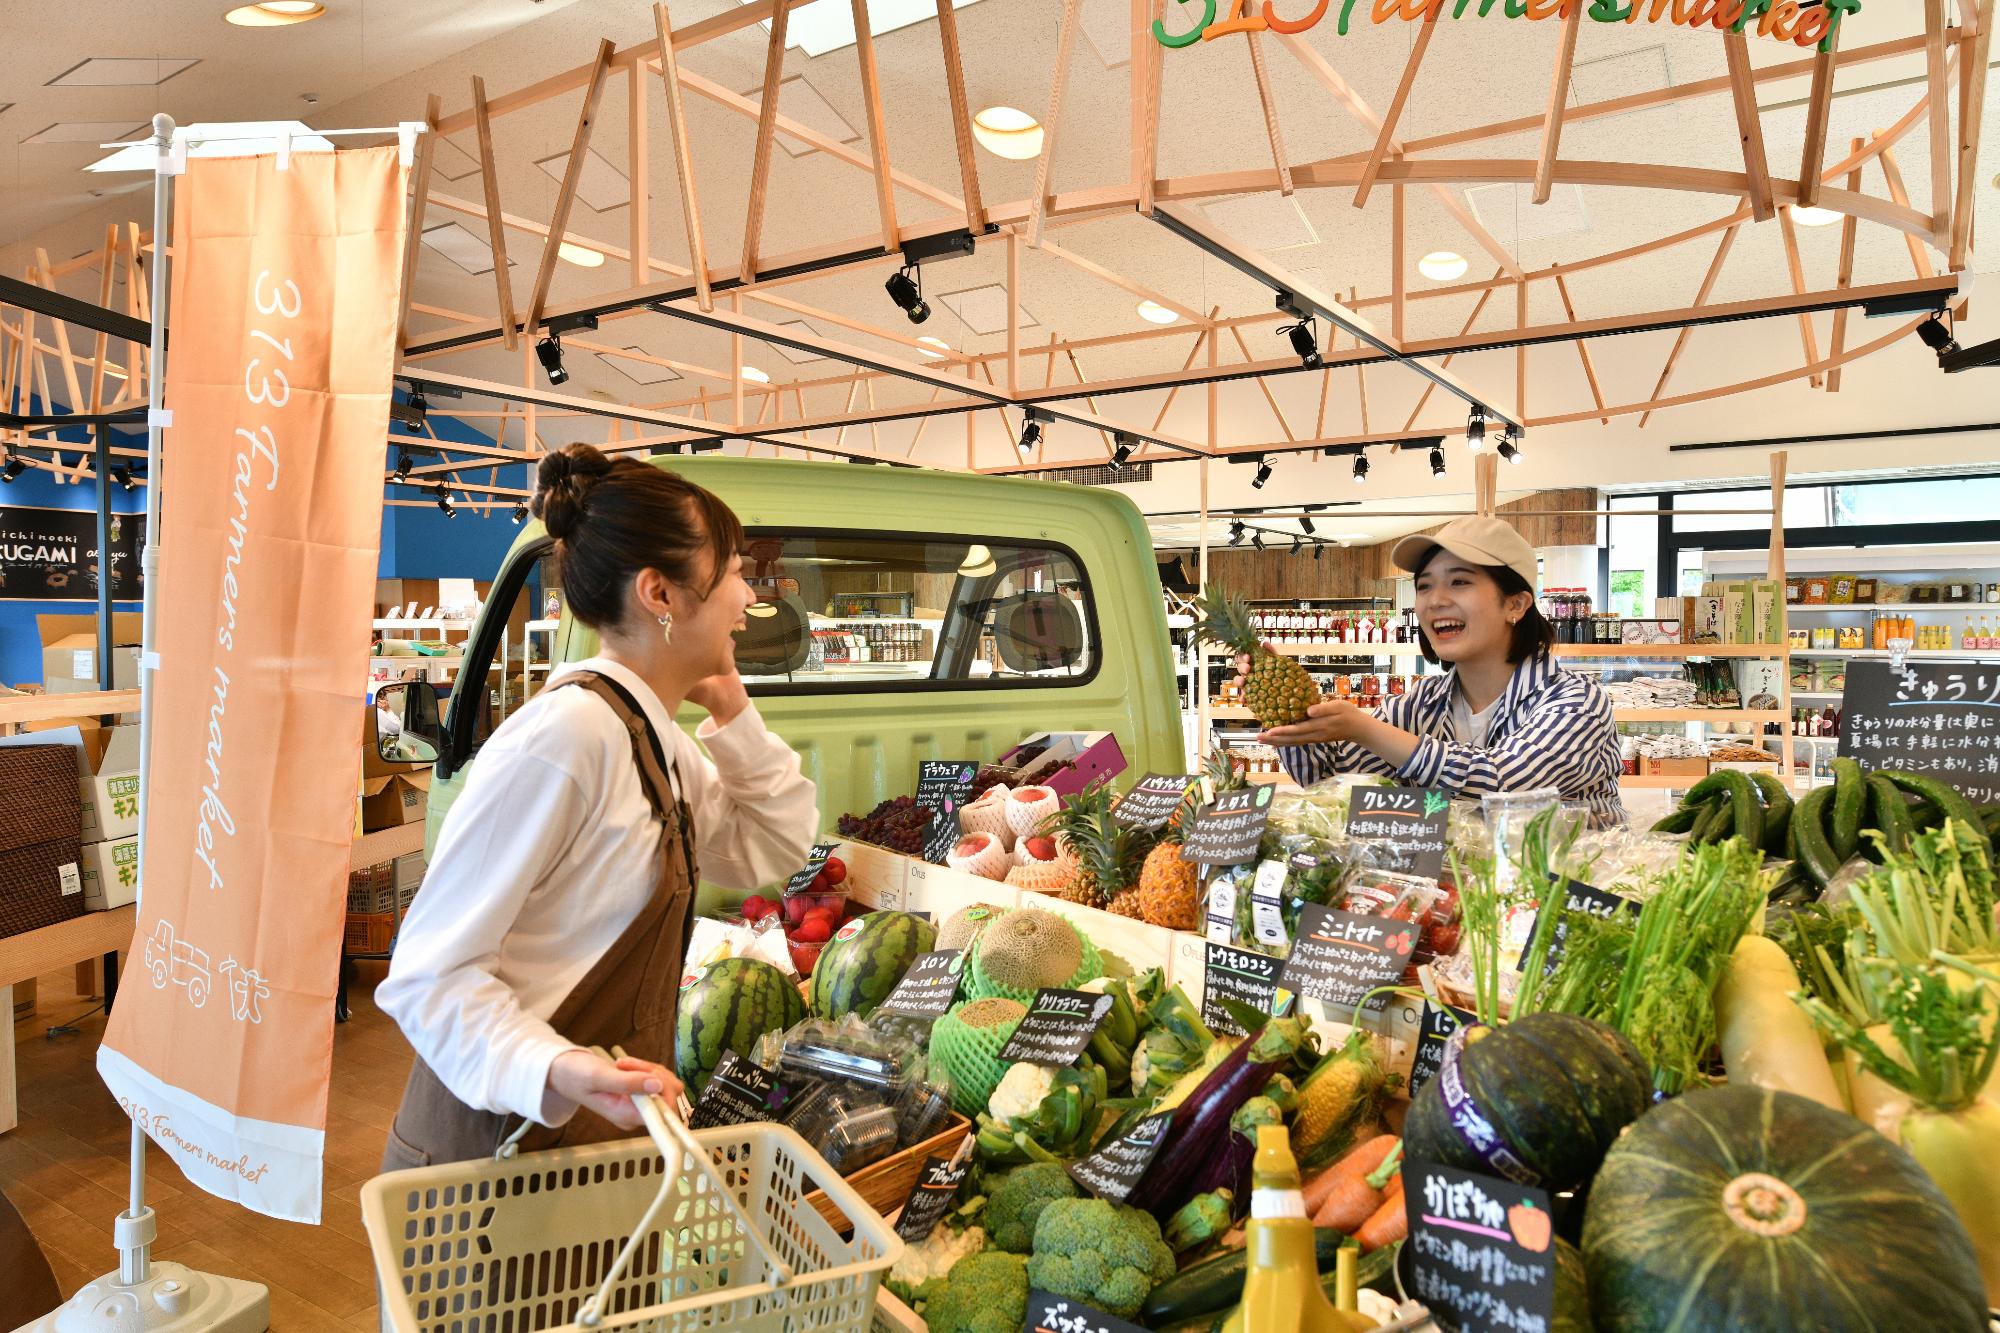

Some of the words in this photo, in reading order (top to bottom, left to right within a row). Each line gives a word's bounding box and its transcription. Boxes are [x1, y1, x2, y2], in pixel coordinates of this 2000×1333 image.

[245, 269, 301, 408] 313
[1896, 669, 2000, 704] きゅうり
[195, 665, 236, 889] market
[924, 761, 960, 778] デラウェア
[1215, 793, 1250, 812] レタス
[1363, 791, 1417, 810] クレソン
[1316, 913, 1384, 943] ミニトマト
[915, 955, 949, 973] メロン
[1208, 945, 1274, 976] トウモロコシ
[1038, 992, 1090, 1012] カリフラワー
[206, 1154, 268, 1185] market
[1423, 1174, 1505, 1229] かぼちゃ
